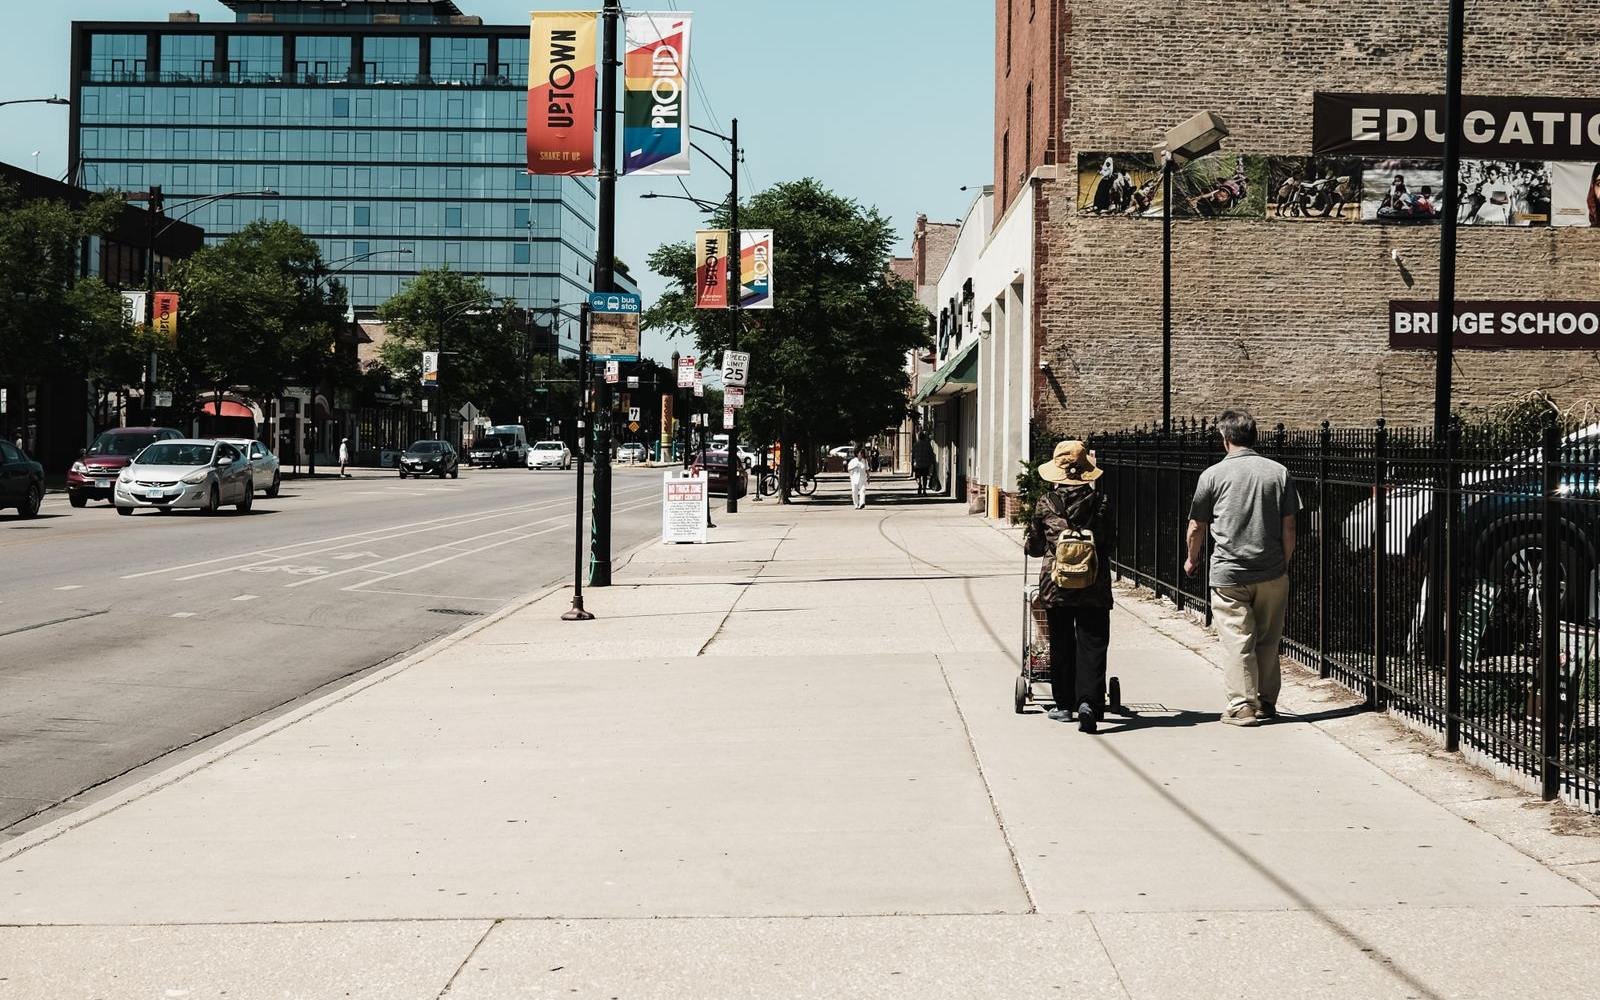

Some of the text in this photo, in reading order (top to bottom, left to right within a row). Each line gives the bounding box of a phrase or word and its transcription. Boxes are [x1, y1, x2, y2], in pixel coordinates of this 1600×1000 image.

[548, 30, 576, 128] UPTOWN
[651, 44, 679, 129] PROUD
[540, 151, 560, 161] SHAKE
[563, 151, 569, 161] IT
[753, 245, 768, 286] PROUD
[621, 296, 635, 304] bus
[621, 303, 638, 311] stop
[726, 353, 747, 361] SPEED
[724, 367, 744, 381] 25
